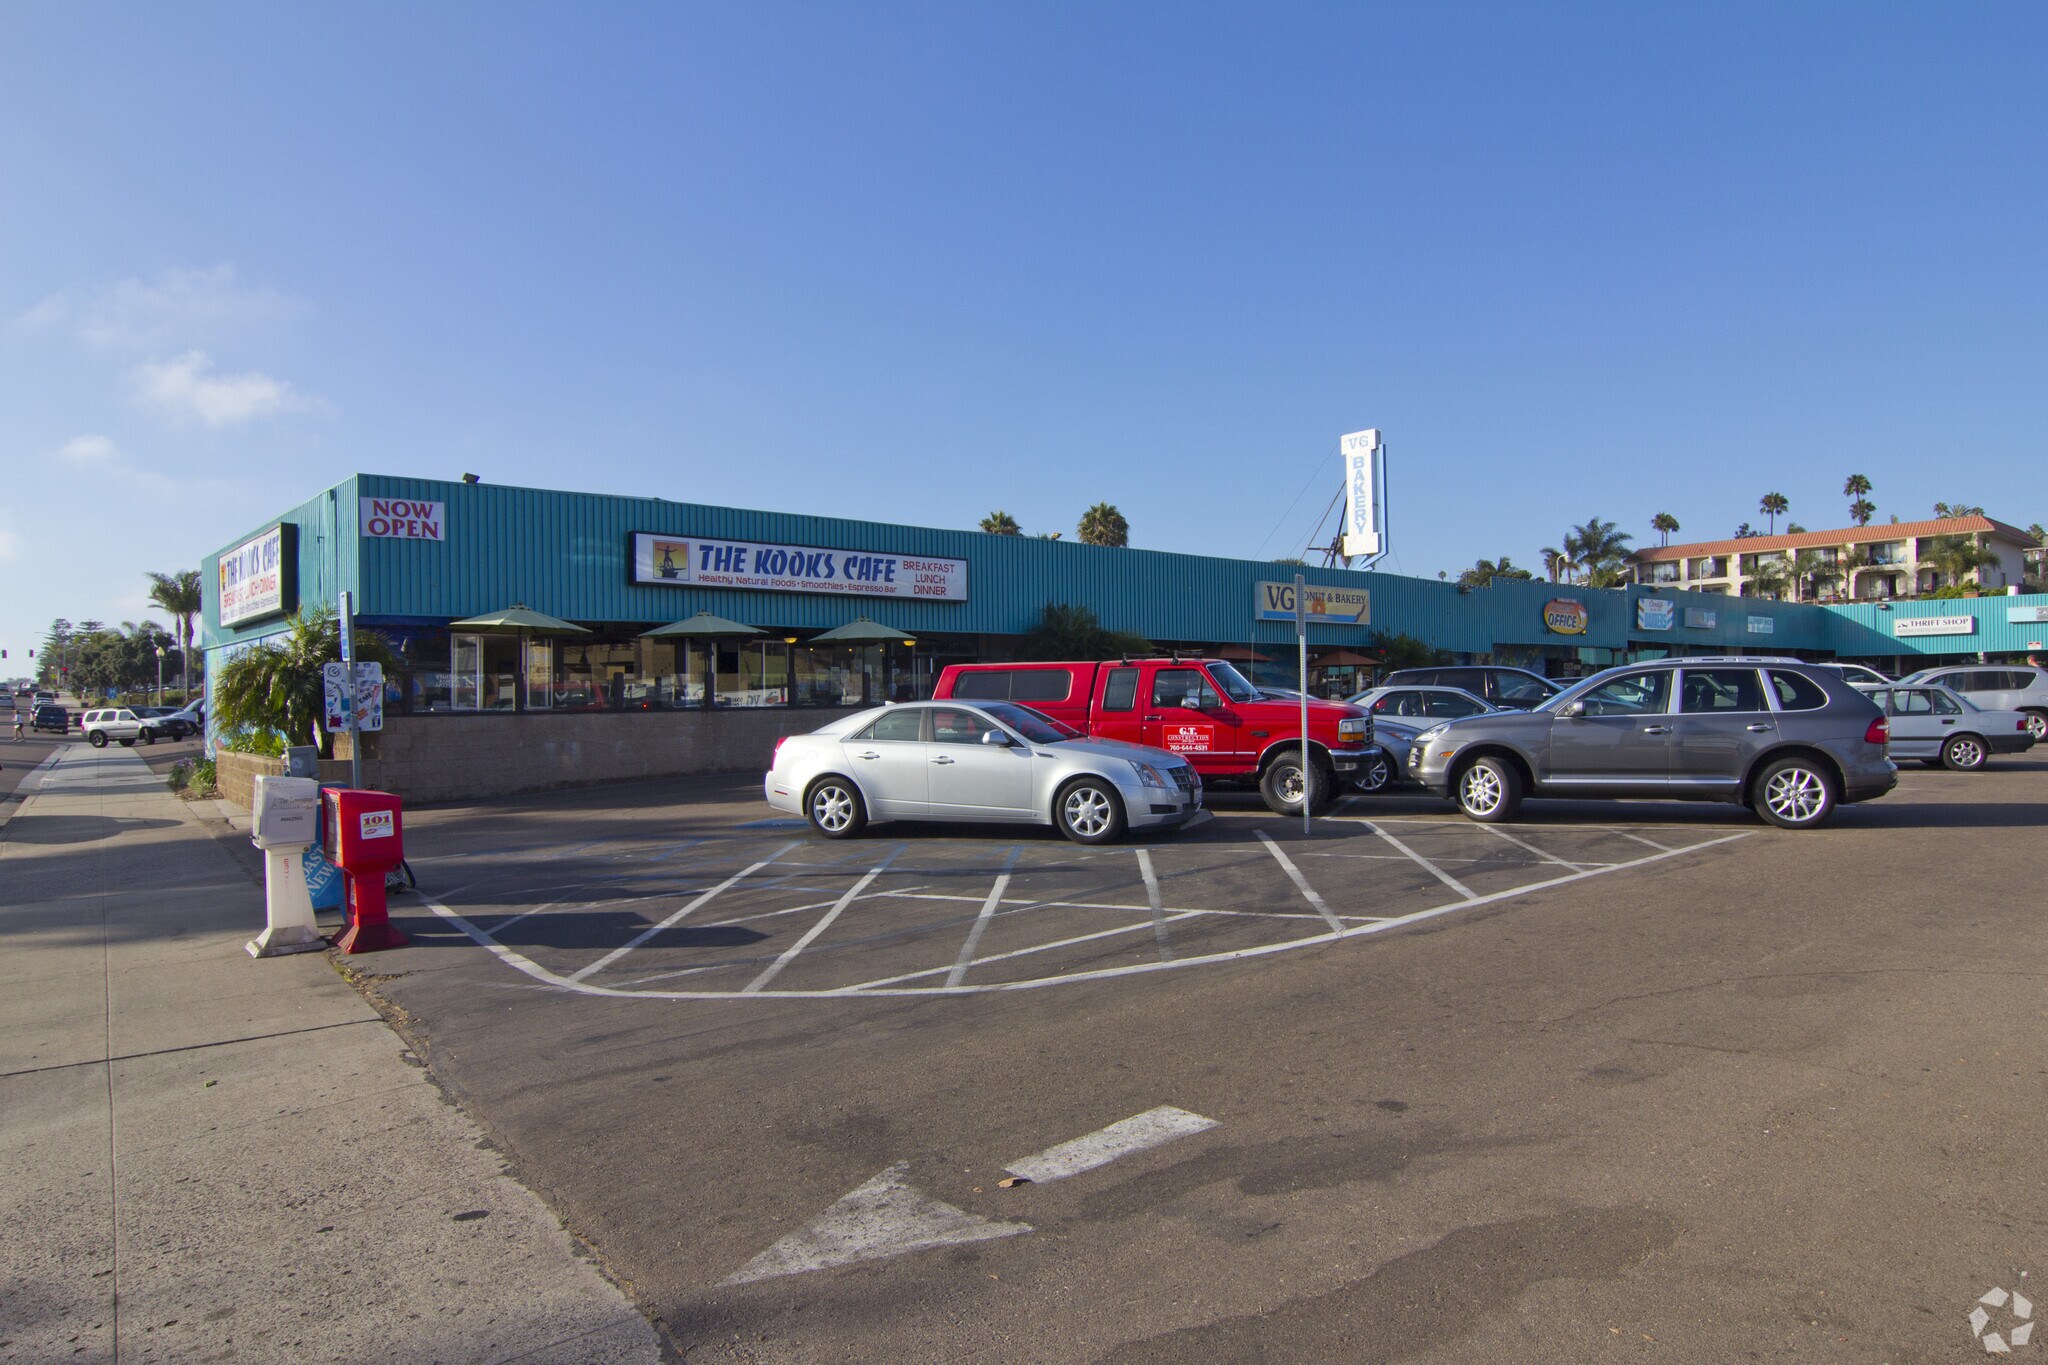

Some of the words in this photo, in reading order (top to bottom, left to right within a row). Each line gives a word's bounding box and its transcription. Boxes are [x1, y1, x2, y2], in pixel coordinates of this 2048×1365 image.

[1348, 435, 1369, 449] VG
[1353, 455, 1367, 534] BAKERY
[373, 499, 433, 519] NOW
[368, 517, 439, 539] OPEN
[699, 544, 747, 573] THE
[843, 555, 896, 582] CAFE
[903, 560, 955, 573] BREAKFAST
[227, 556, 238, 587] THE
[915, 573, 946, 584] LUNCH
[698, 574, 733, 584] Healthy
[736, 576, 769, 586] Natural
[771, 578, 796, 588] Foods
[800, 580, 844, 590] Smoothies
[848, 583, 883, 593] Espresso
[884, 585, 897, 593] Bar
[913, 584, 946, 595] DINNER
[1267, 585, 1295, 610] VG
[1327, 592, 1334, 603] &
[1335, 593, 1367, 605] BAKERY
[1548, 612, 1577, 628] OFFICE
[1910, 619, 1940, 627] THRIFT
[1943, 618, 1969, 626] SHOP
[1179, 727, 1197, 735] G.T.
[363, 815, 390, 826] 101
